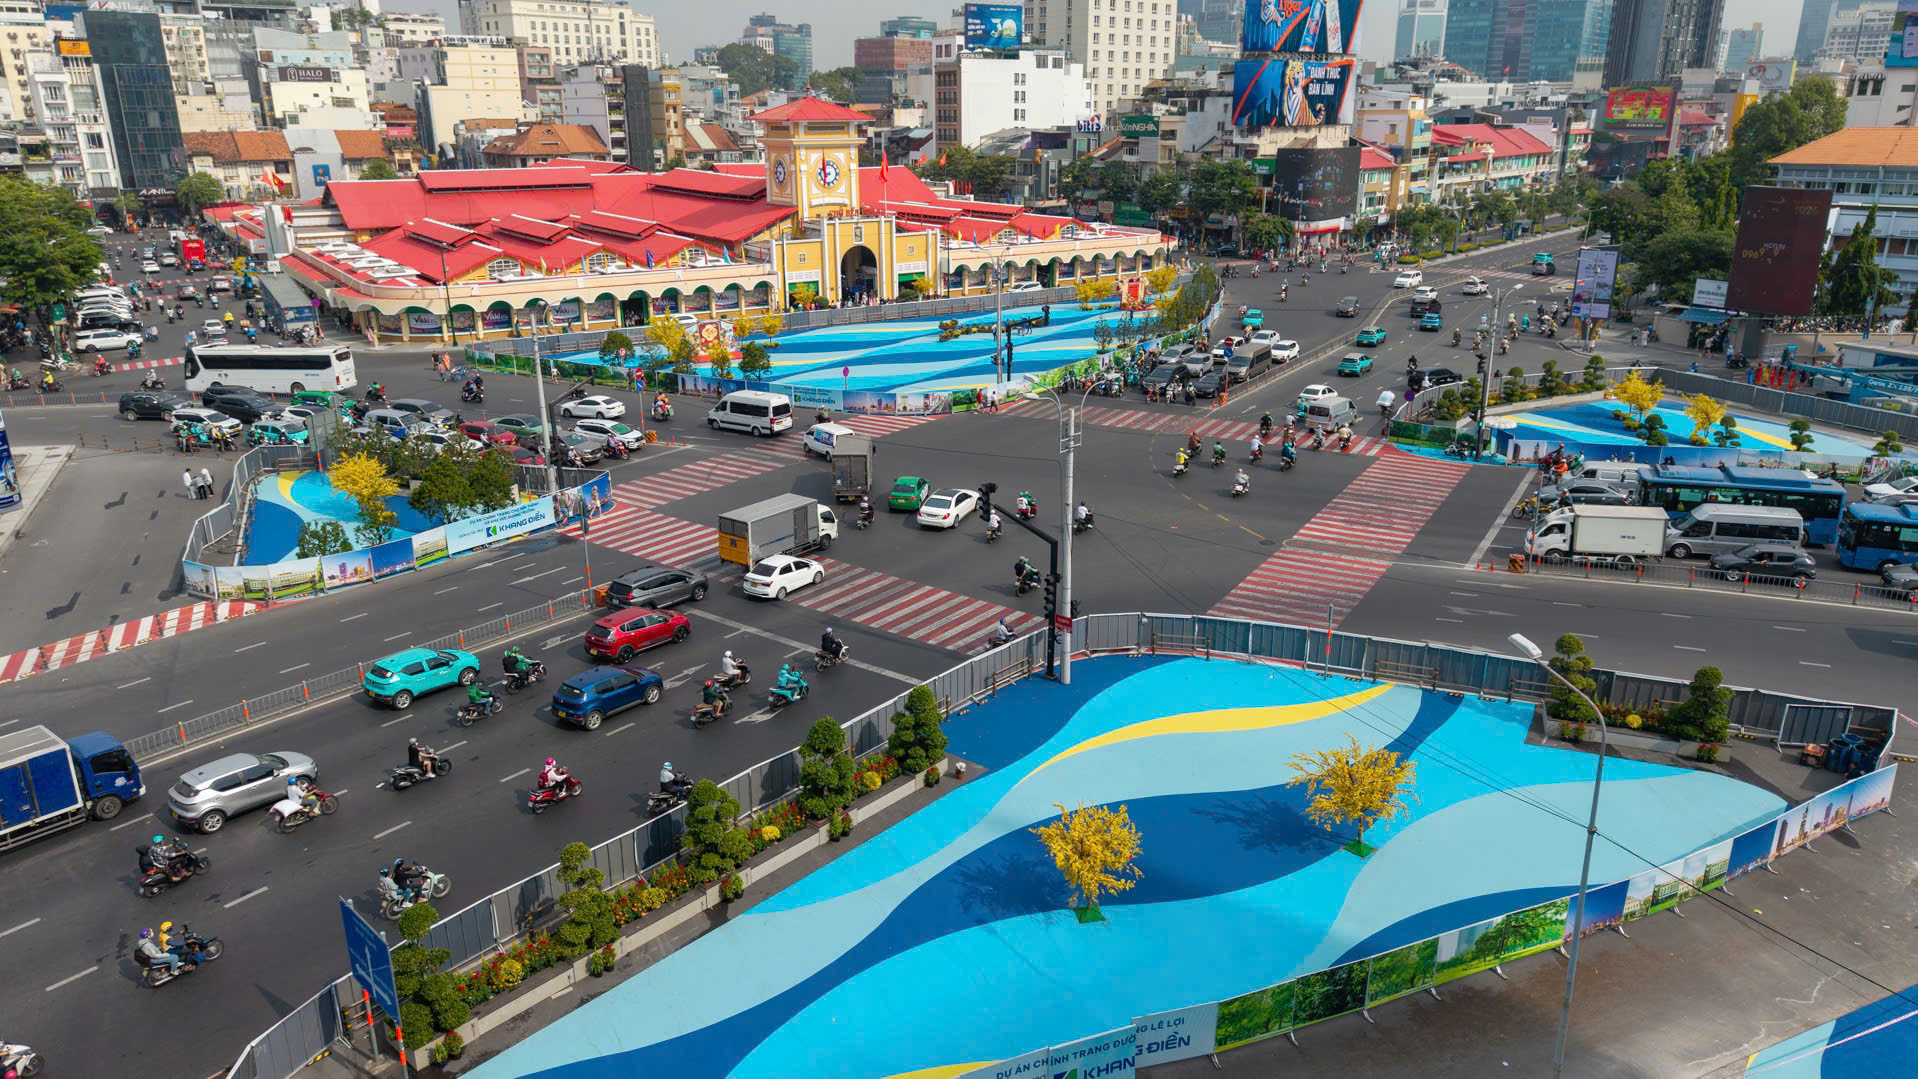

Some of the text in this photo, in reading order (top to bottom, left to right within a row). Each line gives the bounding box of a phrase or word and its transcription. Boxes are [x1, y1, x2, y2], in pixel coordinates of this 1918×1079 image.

[1308, 80, 1335, 96] BẢN LĨNH
[499, 519, 528, 532] KHANG
[1151, 1020, 1164, 1030] LÊ
[1167, 1017, 1184, 1028] LỢI
[1146, 1032, 1190, 1054] ĐIỀN
[1015, 1062, 1030, 1074] ÁN
[1072, 1042, 1110, 1060] TRANG
